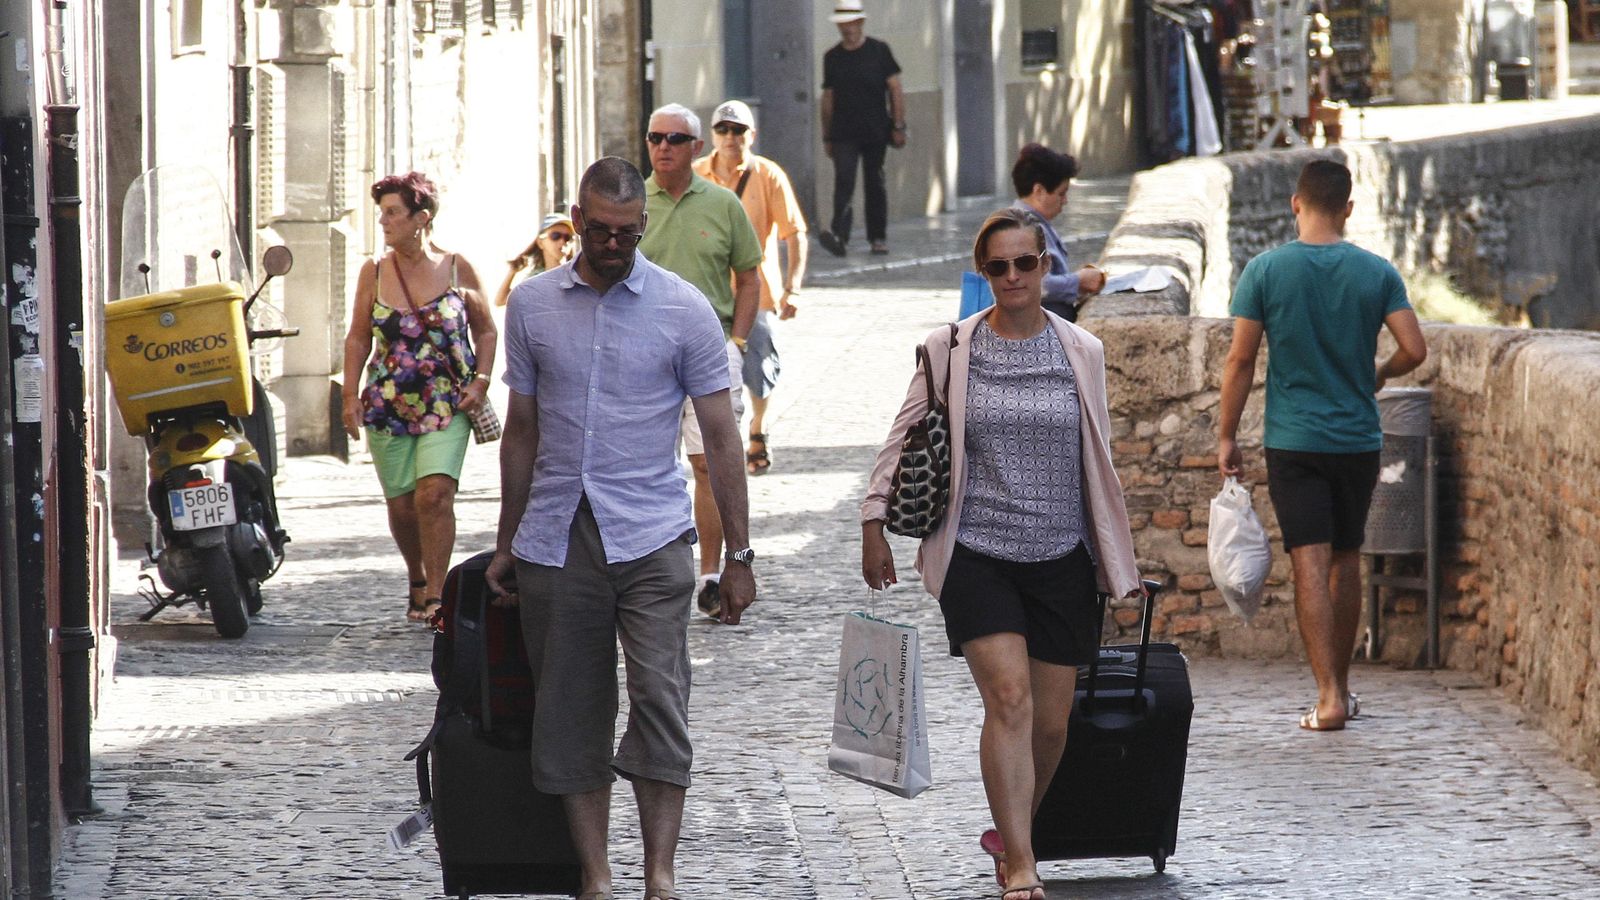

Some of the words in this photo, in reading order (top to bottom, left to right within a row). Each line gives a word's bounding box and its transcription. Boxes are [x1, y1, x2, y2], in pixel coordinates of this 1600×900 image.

[144, 333, 228, 361] CORREOS
[184, 486, 228, 508] 5806
[191, 505, 226, 528] FHF
[898, 633, 909, 686] Alhambra
[898, 687, 905, 697] la
[898, 699, 905, 713] de
